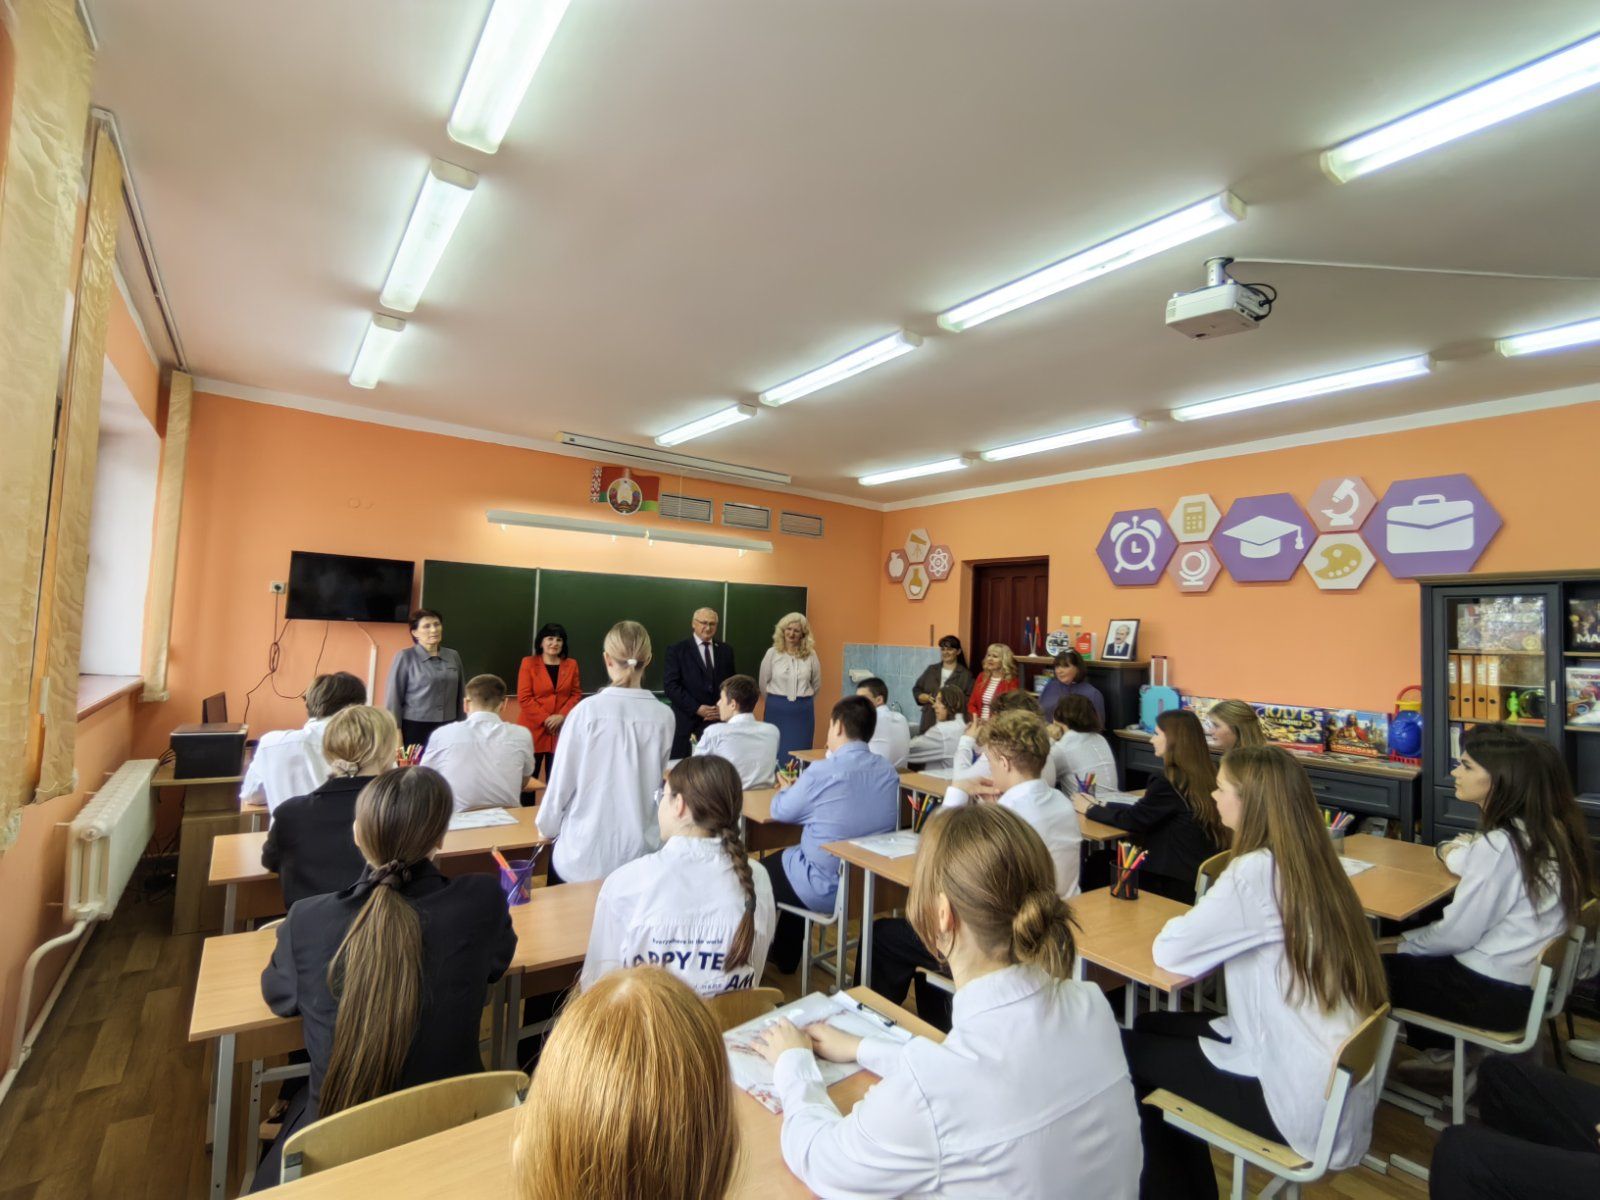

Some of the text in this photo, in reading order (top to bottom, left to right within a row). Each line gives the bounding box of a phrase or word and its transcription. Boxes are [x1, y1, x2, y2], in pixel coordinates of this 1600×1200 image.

[1264, 707, 1312, 721] КЛУБ
[623, 951, 725, 970] APPY TE
[724, 971, 755, 990] AM
